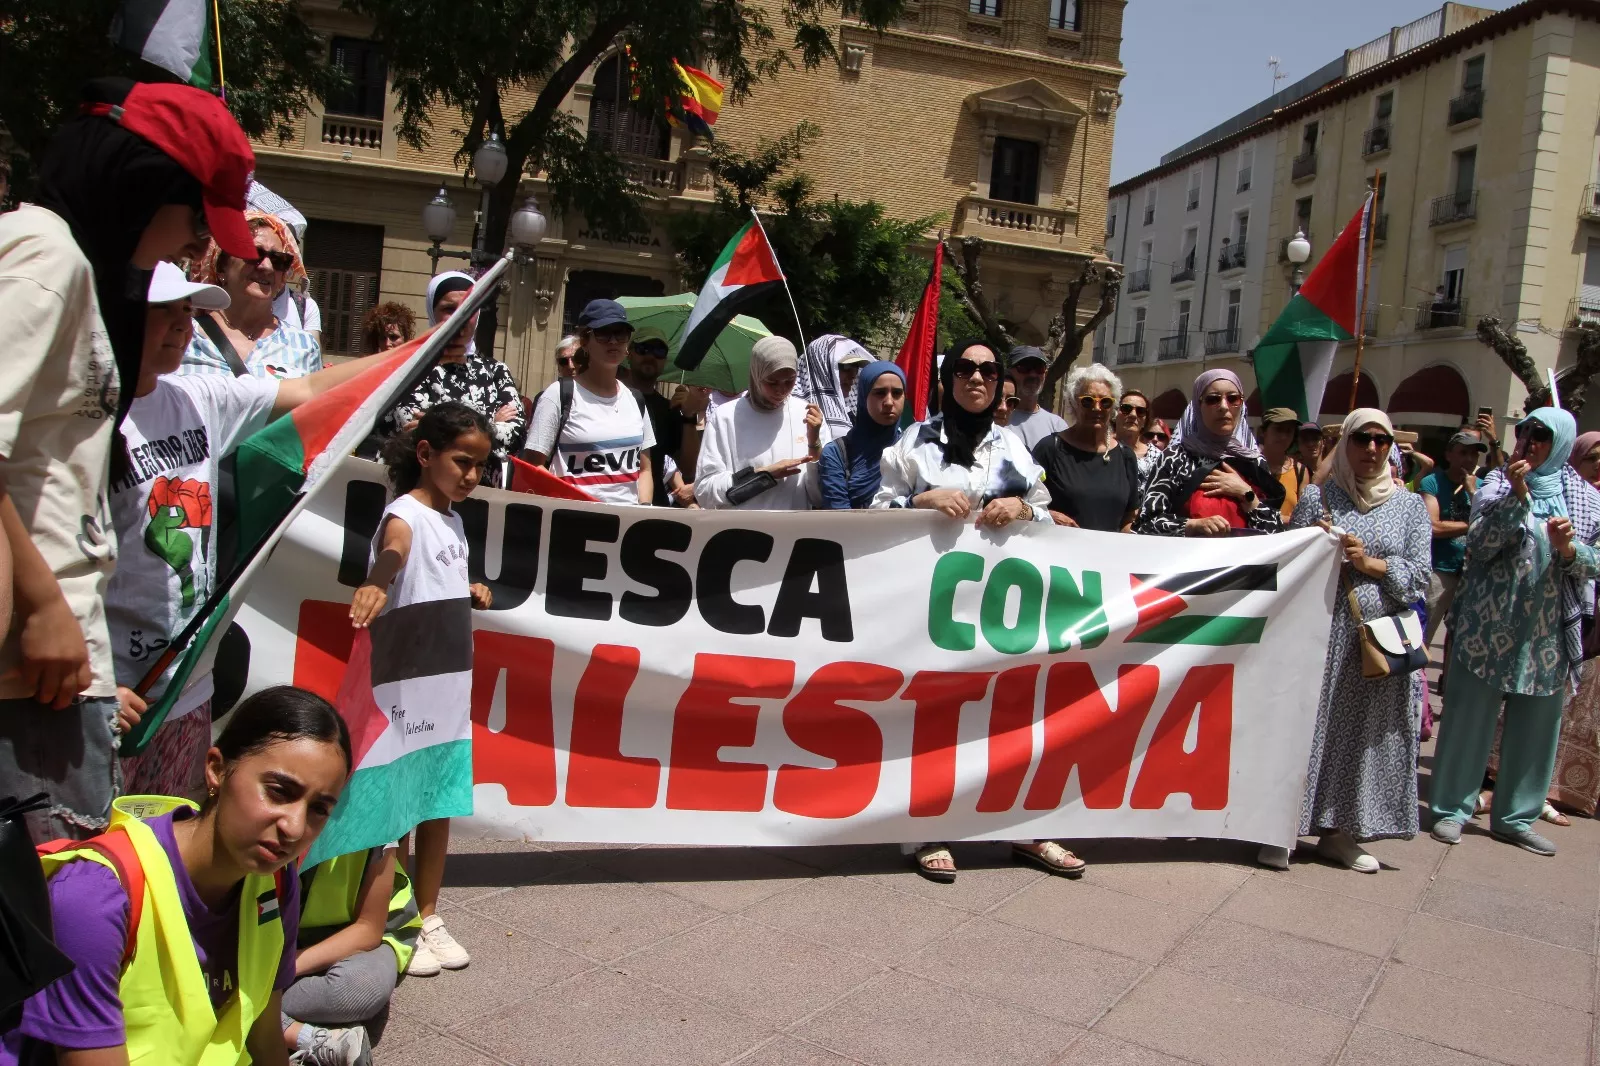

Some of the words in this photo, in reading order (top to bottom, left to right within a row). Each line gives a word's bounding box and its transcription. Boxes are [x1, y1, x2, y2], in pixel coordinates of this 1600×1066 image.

[928, 551, 1110, 654] CON
[391, 705, 406, 723] Free
[405, 720, 435, 736] Palestina
